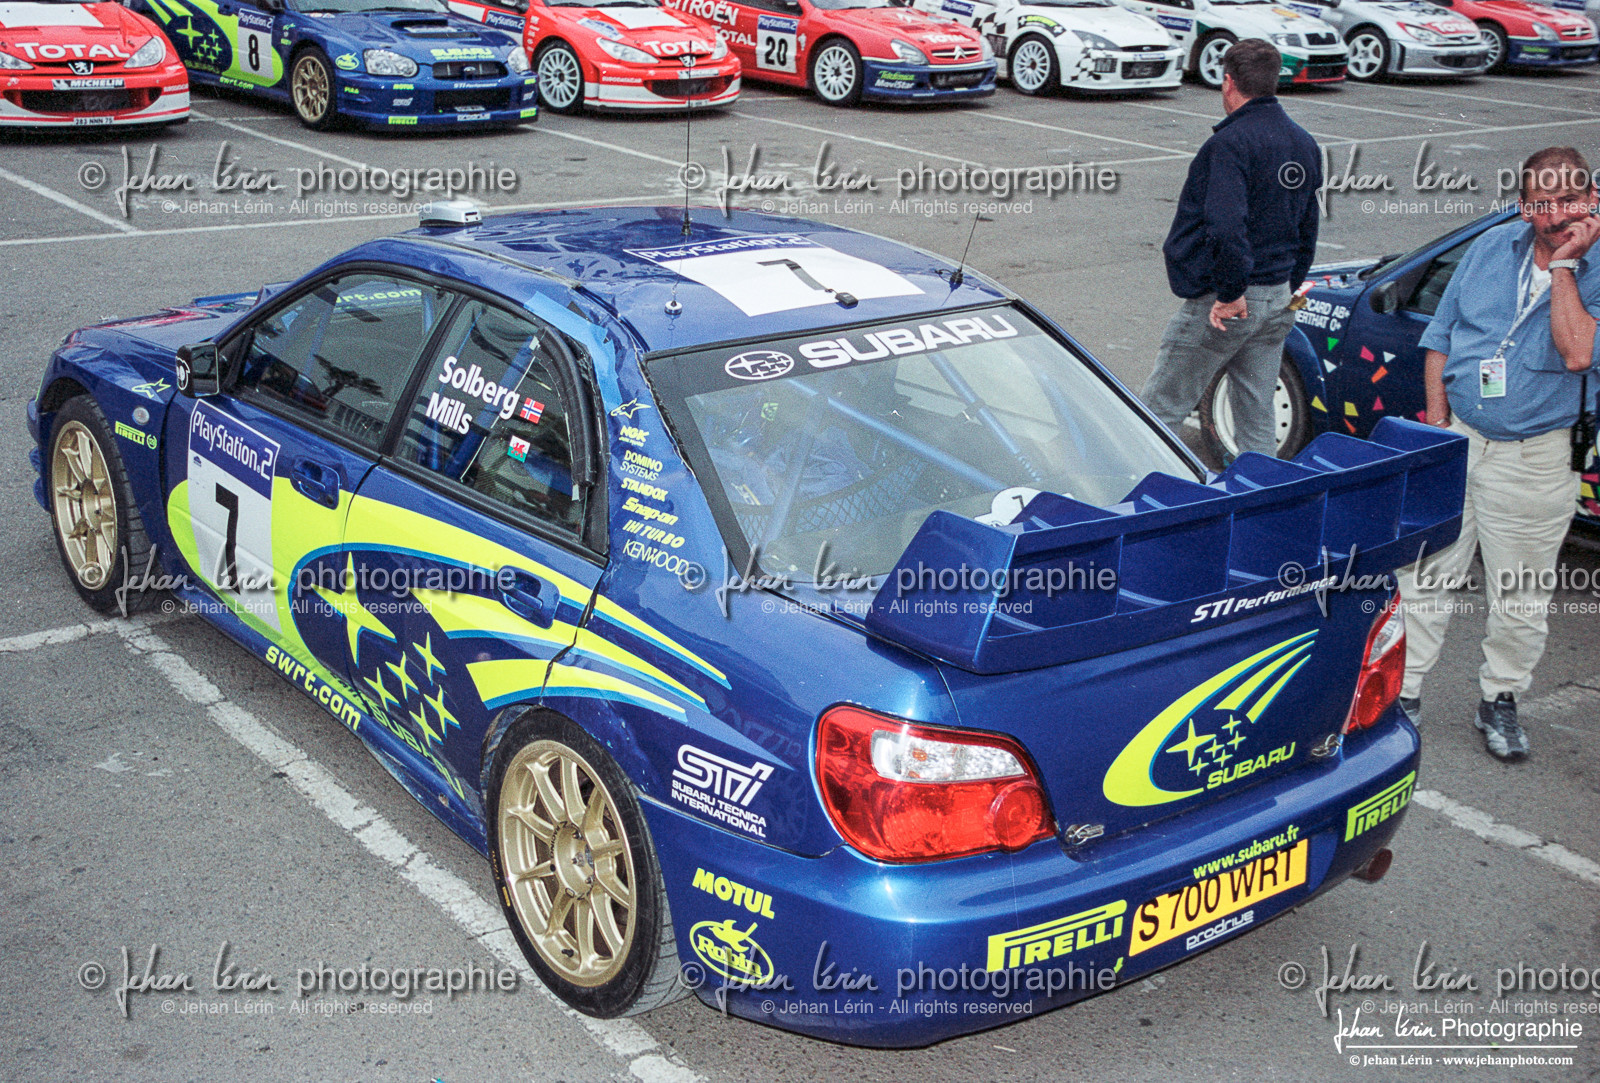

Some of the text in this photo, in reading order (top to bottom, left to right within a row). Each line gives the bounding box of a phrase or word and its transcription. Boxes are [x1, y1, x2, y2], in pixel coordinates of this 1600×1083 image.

[15, 42, 130, 59] TOTAL
[248, 33, 261, 71] 8
[430, 48, 493, 56] SUBARU
[643, 40, 714, 56] TOTAL
[712, 25, 757, 47] TOTAL
[764, 35, 789, 67] 20
[922, 34, 973, 43] TOTAL
[70, 79, 124, 88] MICHELIN
[756, 258, 829, 292] 7
[336, 289, 422, 303] rt.com
[1303, 298, 1332, 315] CARD
[798, 312, 1019, 370] SUBARU
[439, 356, 520, 420] Solberg
[426, 392, 473, 435] Mills
[115, 420, 146, 446] PIRELLI
[620, 425, 650, 443] NGK
[620, 461, 659, 481] SYSTEMS
[624, 450, 663, 472] DOMINO
[621, 477, 668, 502] STANDOX
[622, 497, 679, 526] Snap-on
[215, 482, 241, 595] 7
[622, 519, 685, 549] IHI TURBO
[622, 539, 689, 576] KENWOOD
[1190, 575, 1339, 624] STI Performance
[265, 645, 362, 731] swrt.com
[1206, 741, 1296, 790] SUBARU
[671, 779, 767, 828] SUBARU TECNICA
[671, 788, 767, 838] INTERNATIONAL
[1344, 769, 1416, 843] PIRELLI
[1193, 824, 1300, 880] www.subaru.fr
[692, 867, 775, 920] MOTUL
[1138, 844, 1298, 942] S 700 WRT
[986, 899, 1127, 973] PIRELLI
[1186, 910, 1254, 951] prodrive
[697, 934, 763, 977] Robin
